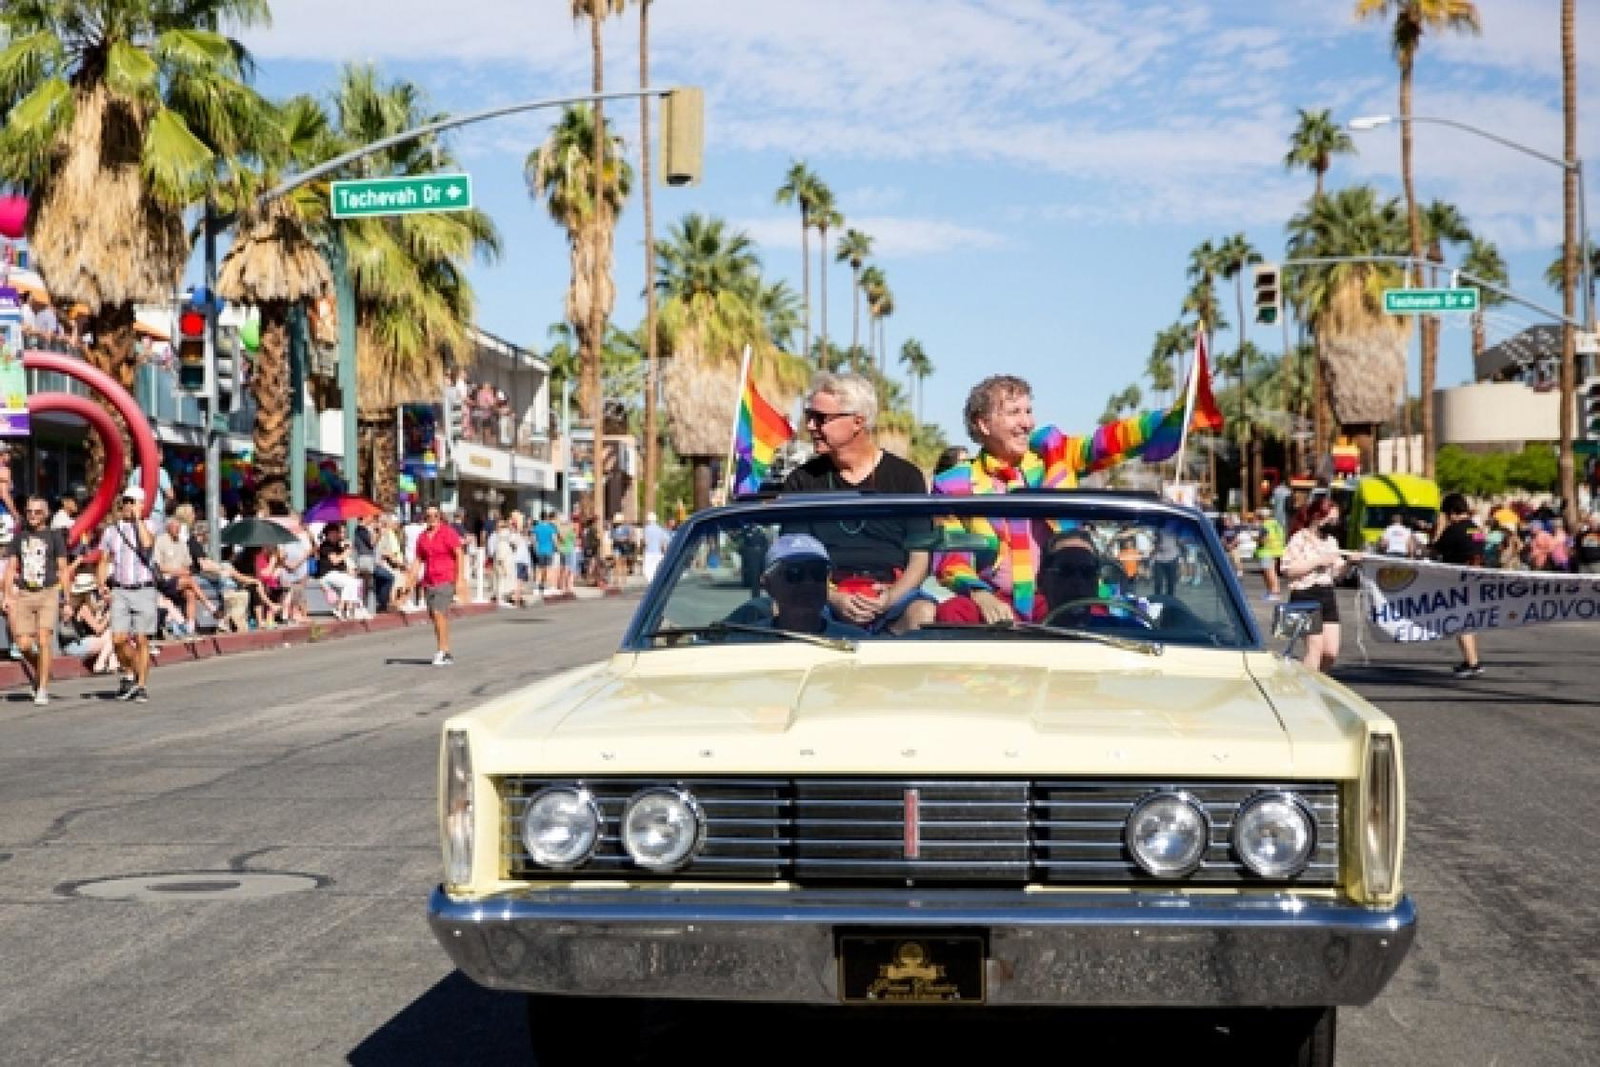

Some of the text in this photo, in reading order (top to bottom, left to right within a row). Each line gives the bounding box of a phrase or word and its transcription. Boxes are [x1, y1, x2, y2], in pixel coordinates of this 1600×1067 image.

[423, 184, 441, 204] Dr
[1369, 586, 1468, 623] HUMAN
[1394, 597, 1600, 643] EDUCATE ADVO
